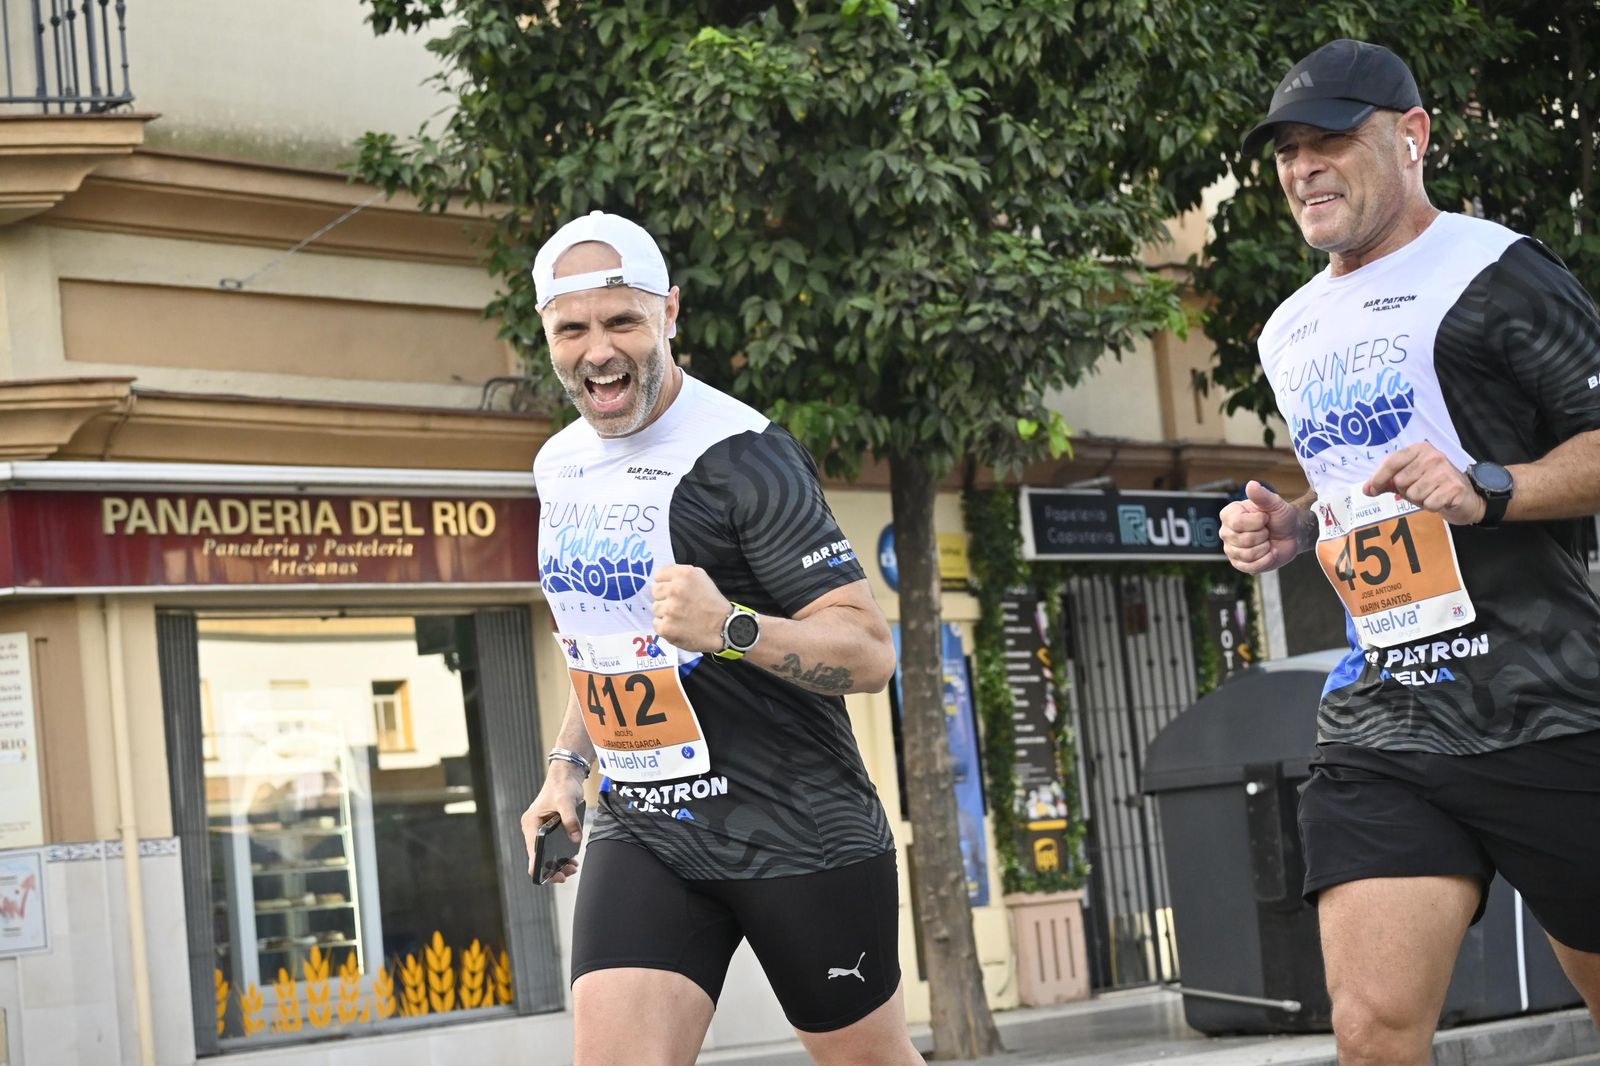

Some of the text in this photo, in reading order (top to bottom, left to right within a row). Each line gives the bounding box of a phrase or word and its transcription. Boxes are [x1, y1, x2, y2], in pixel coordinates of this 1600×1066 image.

[1363, 299, 1379, 309] BAR
[1372, 304, 1400, 312] HUELVA
[1280, 334, 1410, 396] RUNNERS
[1301, 359, 1410, 428] Palmera
[102, 497, 496, 537] PANADERIA DEL RIO
[541, 502, 660, 533] RUNNERS
[1356, 506, 1382, 518] HUELVA
[1117, 504, 1220, 548] Rubio
[202, 537, 300, 557] Panaderia
[305, 543, 317, 561] y
[556, 511, 652, 573] Palmera
[1335, 516, 1422, 591] 451
[267, 558, 359, 576] Artesanas
[802, 546, 831, 569] BAR
[1360, 592, 1412, 613] MARIN SANTOS
[1361, 582, 1402, 599] JOSE ANTONIO
[1362, 610, 1418, 635] Huelva
[1384, 632, 1489, 668] PATRÓN
[636, 657, 668, 669] HUELVA
[587, 673, 667, 727] 412
[634, 738, 662, 749] GARCIA
[606, 751, 659, 770] Huelva
